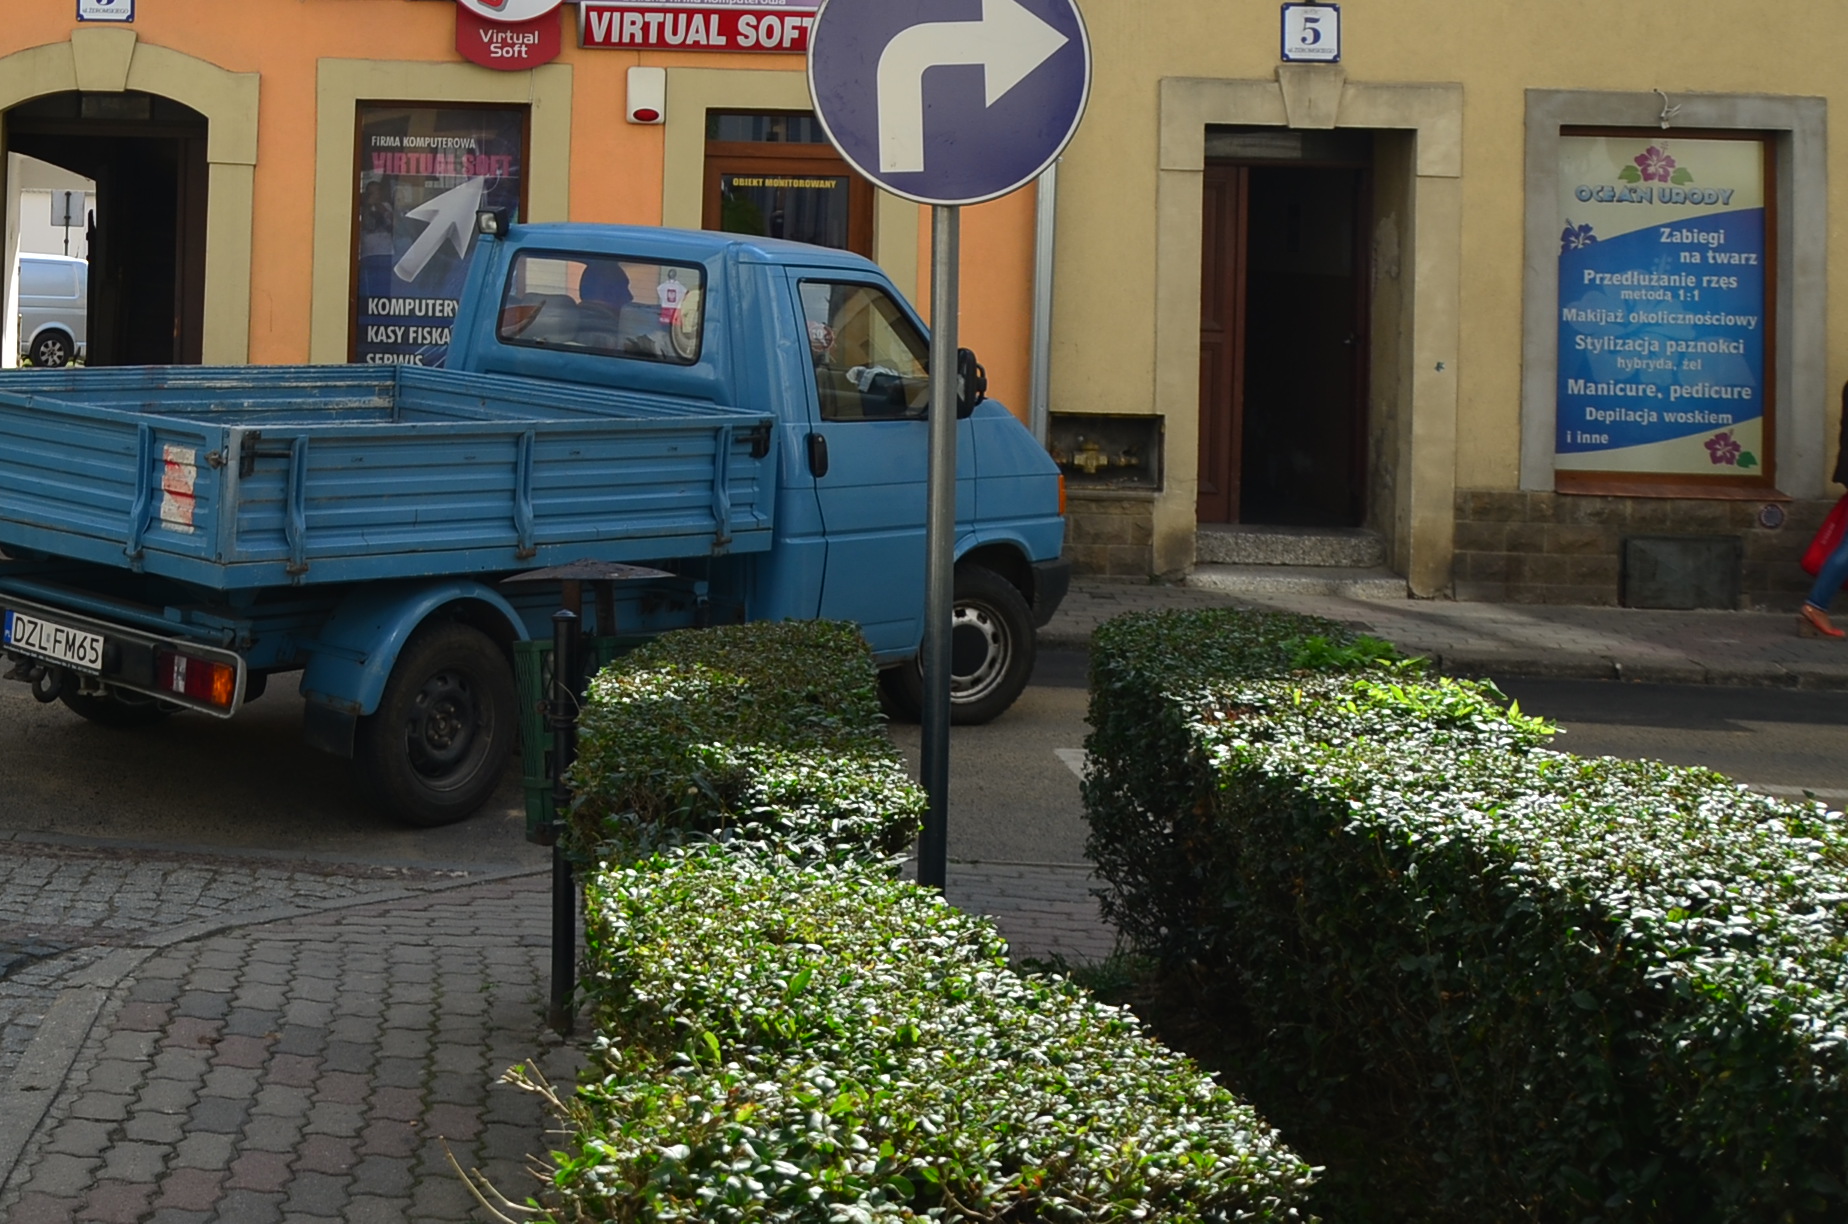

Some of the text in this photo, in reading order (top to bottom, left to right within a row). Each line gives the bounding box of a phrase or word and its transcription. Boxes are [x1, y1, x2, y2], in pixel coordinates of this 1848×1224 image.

[479, 28, 539, 45] Virtual
[589, 11, 726, 46] VIRTUAL
[1301, 17, 1321, 45] 5
[490, 42, 529, 59] Soft
[371, 136, 476, 149] FIRMA KOMPUTEROWA
[372, 152, 512, 176] VIRTUAL SOFT
[733, 178, 836, 188] OBIEKT MONITOROWANY
[1658, 188, 1734, 205] URODY
[1660, 228, 1724, 248] Zabiegi
[1680, 250, 1758, 264] na twarz
[1584, 270, 1738, 290] Przedłużanie rzęs
[1621, 289, 1699, 302] metodą 1:1
[1563, 308, 1757, 329] Makijaż okolicznościowy
[367, 326, 404, 343] KASY
[1575, 335, 1744, 355] Stylizacja paznokci
[1617, 357, 1702, 372] hybryda, żel
[1568, 379, 1752, 401] Manicure, pedicure
[1586, 407, 1732, 425] Depilacja woskiem
[1566, 431, 1609, 444] i inne
[14, 617, 47, 651] DZL
[52, 628, 100, 664] FM65
